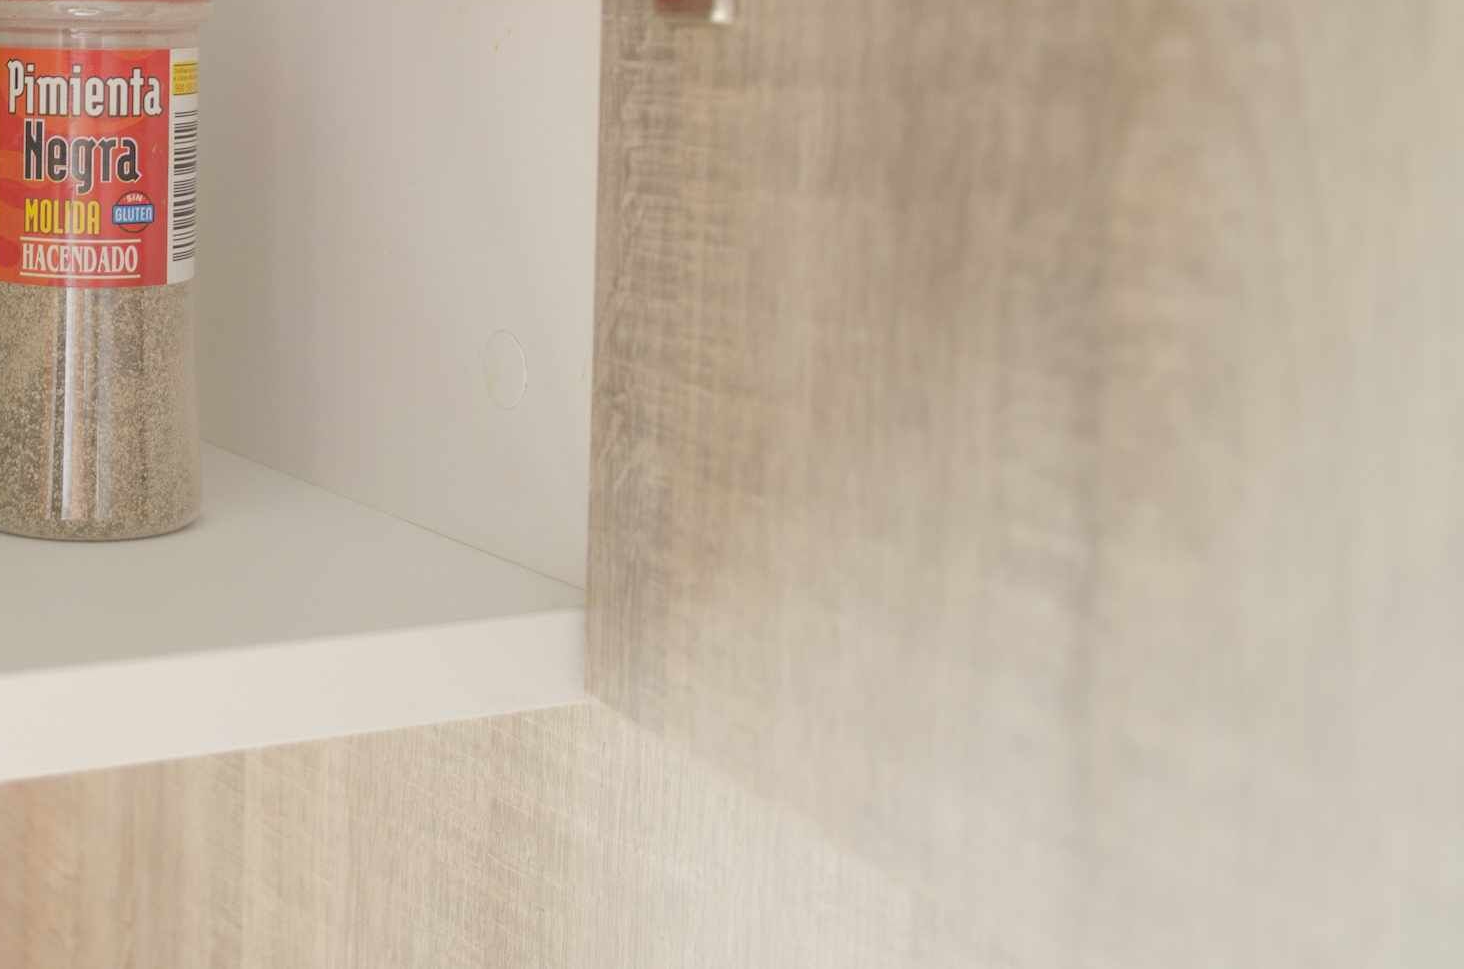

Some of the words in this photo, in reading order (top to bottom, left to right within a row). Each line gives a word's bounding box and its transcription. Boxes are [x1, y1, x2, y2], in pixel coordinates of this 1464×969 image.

[7, 59, 163, 118] Pimienta
[23, 118, 143, 195] Negra
[24, 197, 102, 235] MOLIDA
[115, 206, 153, 223] GLUTEN
[22, 243, 138, 273] HACENDADO
